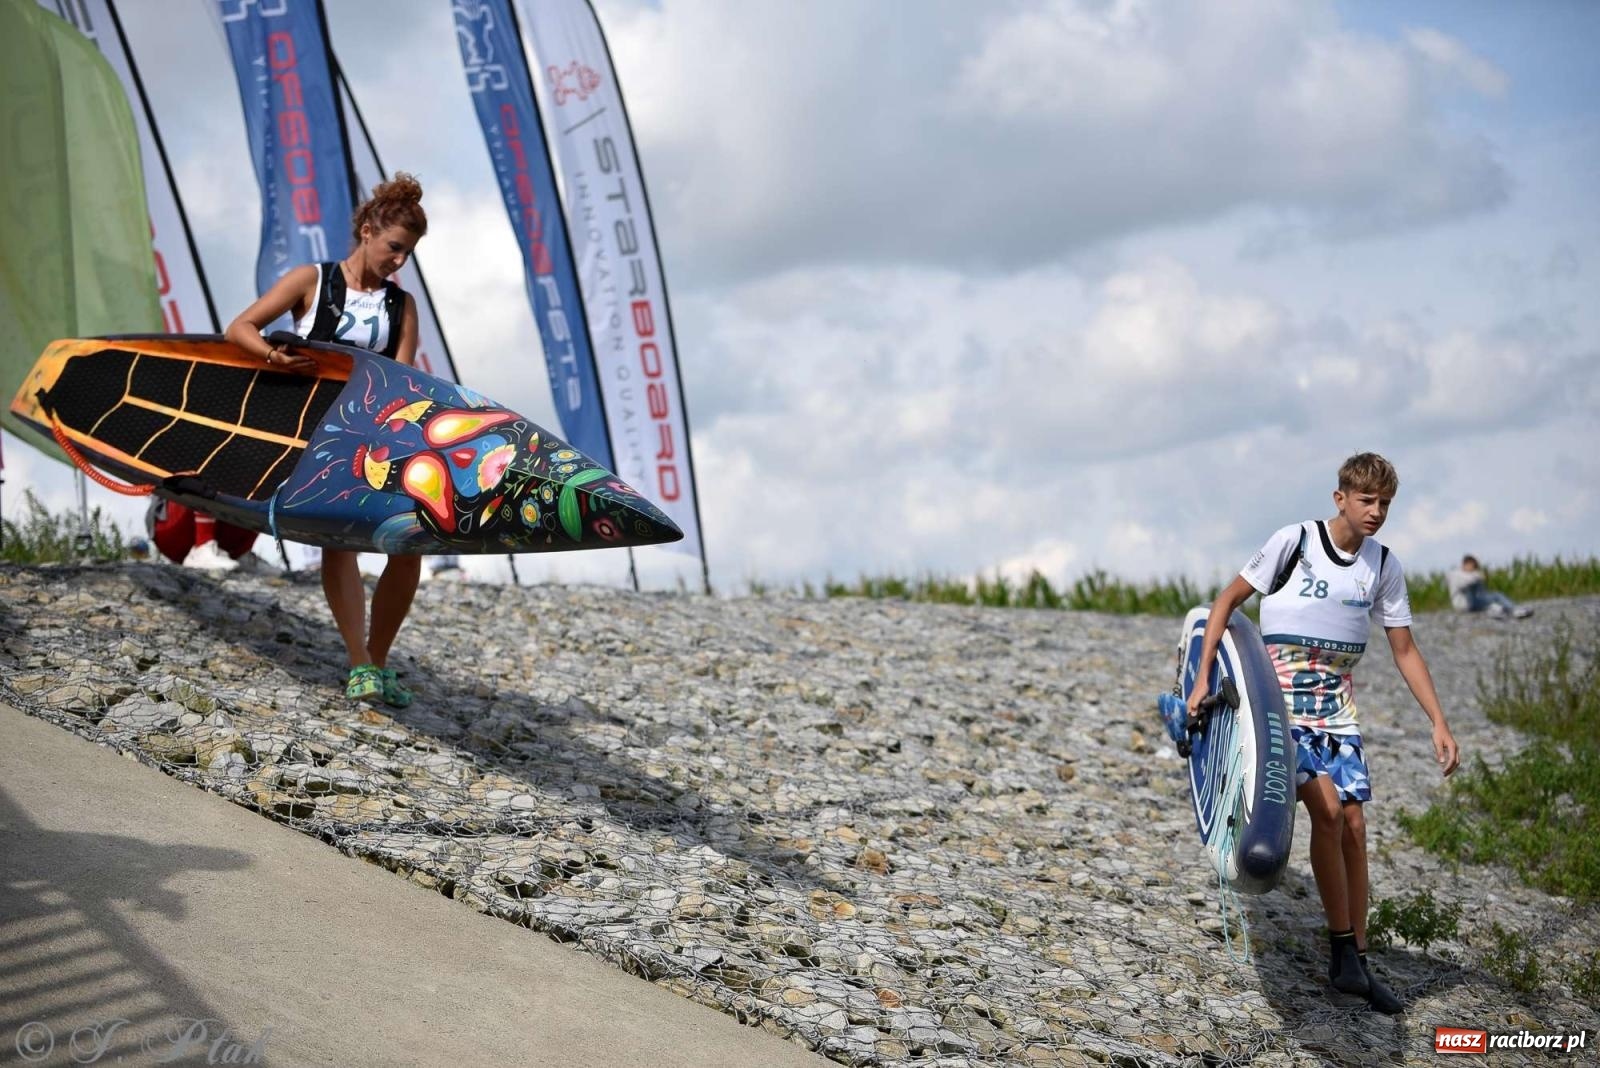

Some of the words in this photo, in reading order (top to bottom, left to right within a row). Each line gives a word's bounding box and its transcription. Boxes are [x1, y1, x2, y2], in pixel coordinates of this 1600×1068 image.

[335, 311, 379, 350] 21
[574, 171, 627, 352] INNOVATION
[615, 364, 645, 481] QUALITY
[1299, 577, 1328, 599] 28
